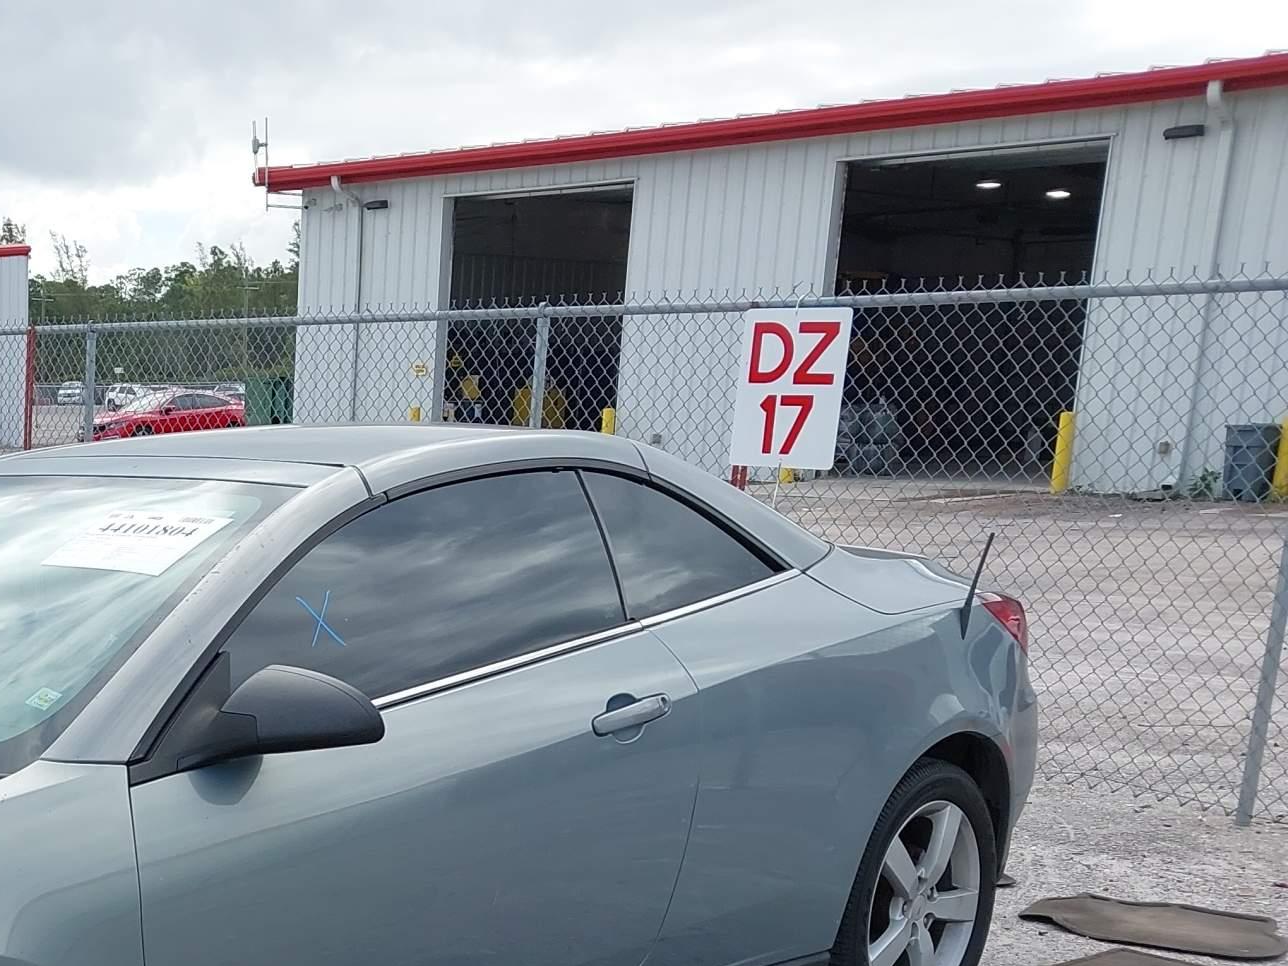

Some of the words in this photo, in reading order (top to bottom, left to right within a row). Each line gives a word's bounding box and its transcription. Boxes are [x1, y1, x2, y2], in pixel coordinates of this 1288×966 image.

[748, 321, 841, 385] DZ
[759, 394, 814, 455] 17
[98, 522, 200, 537] 44101804
